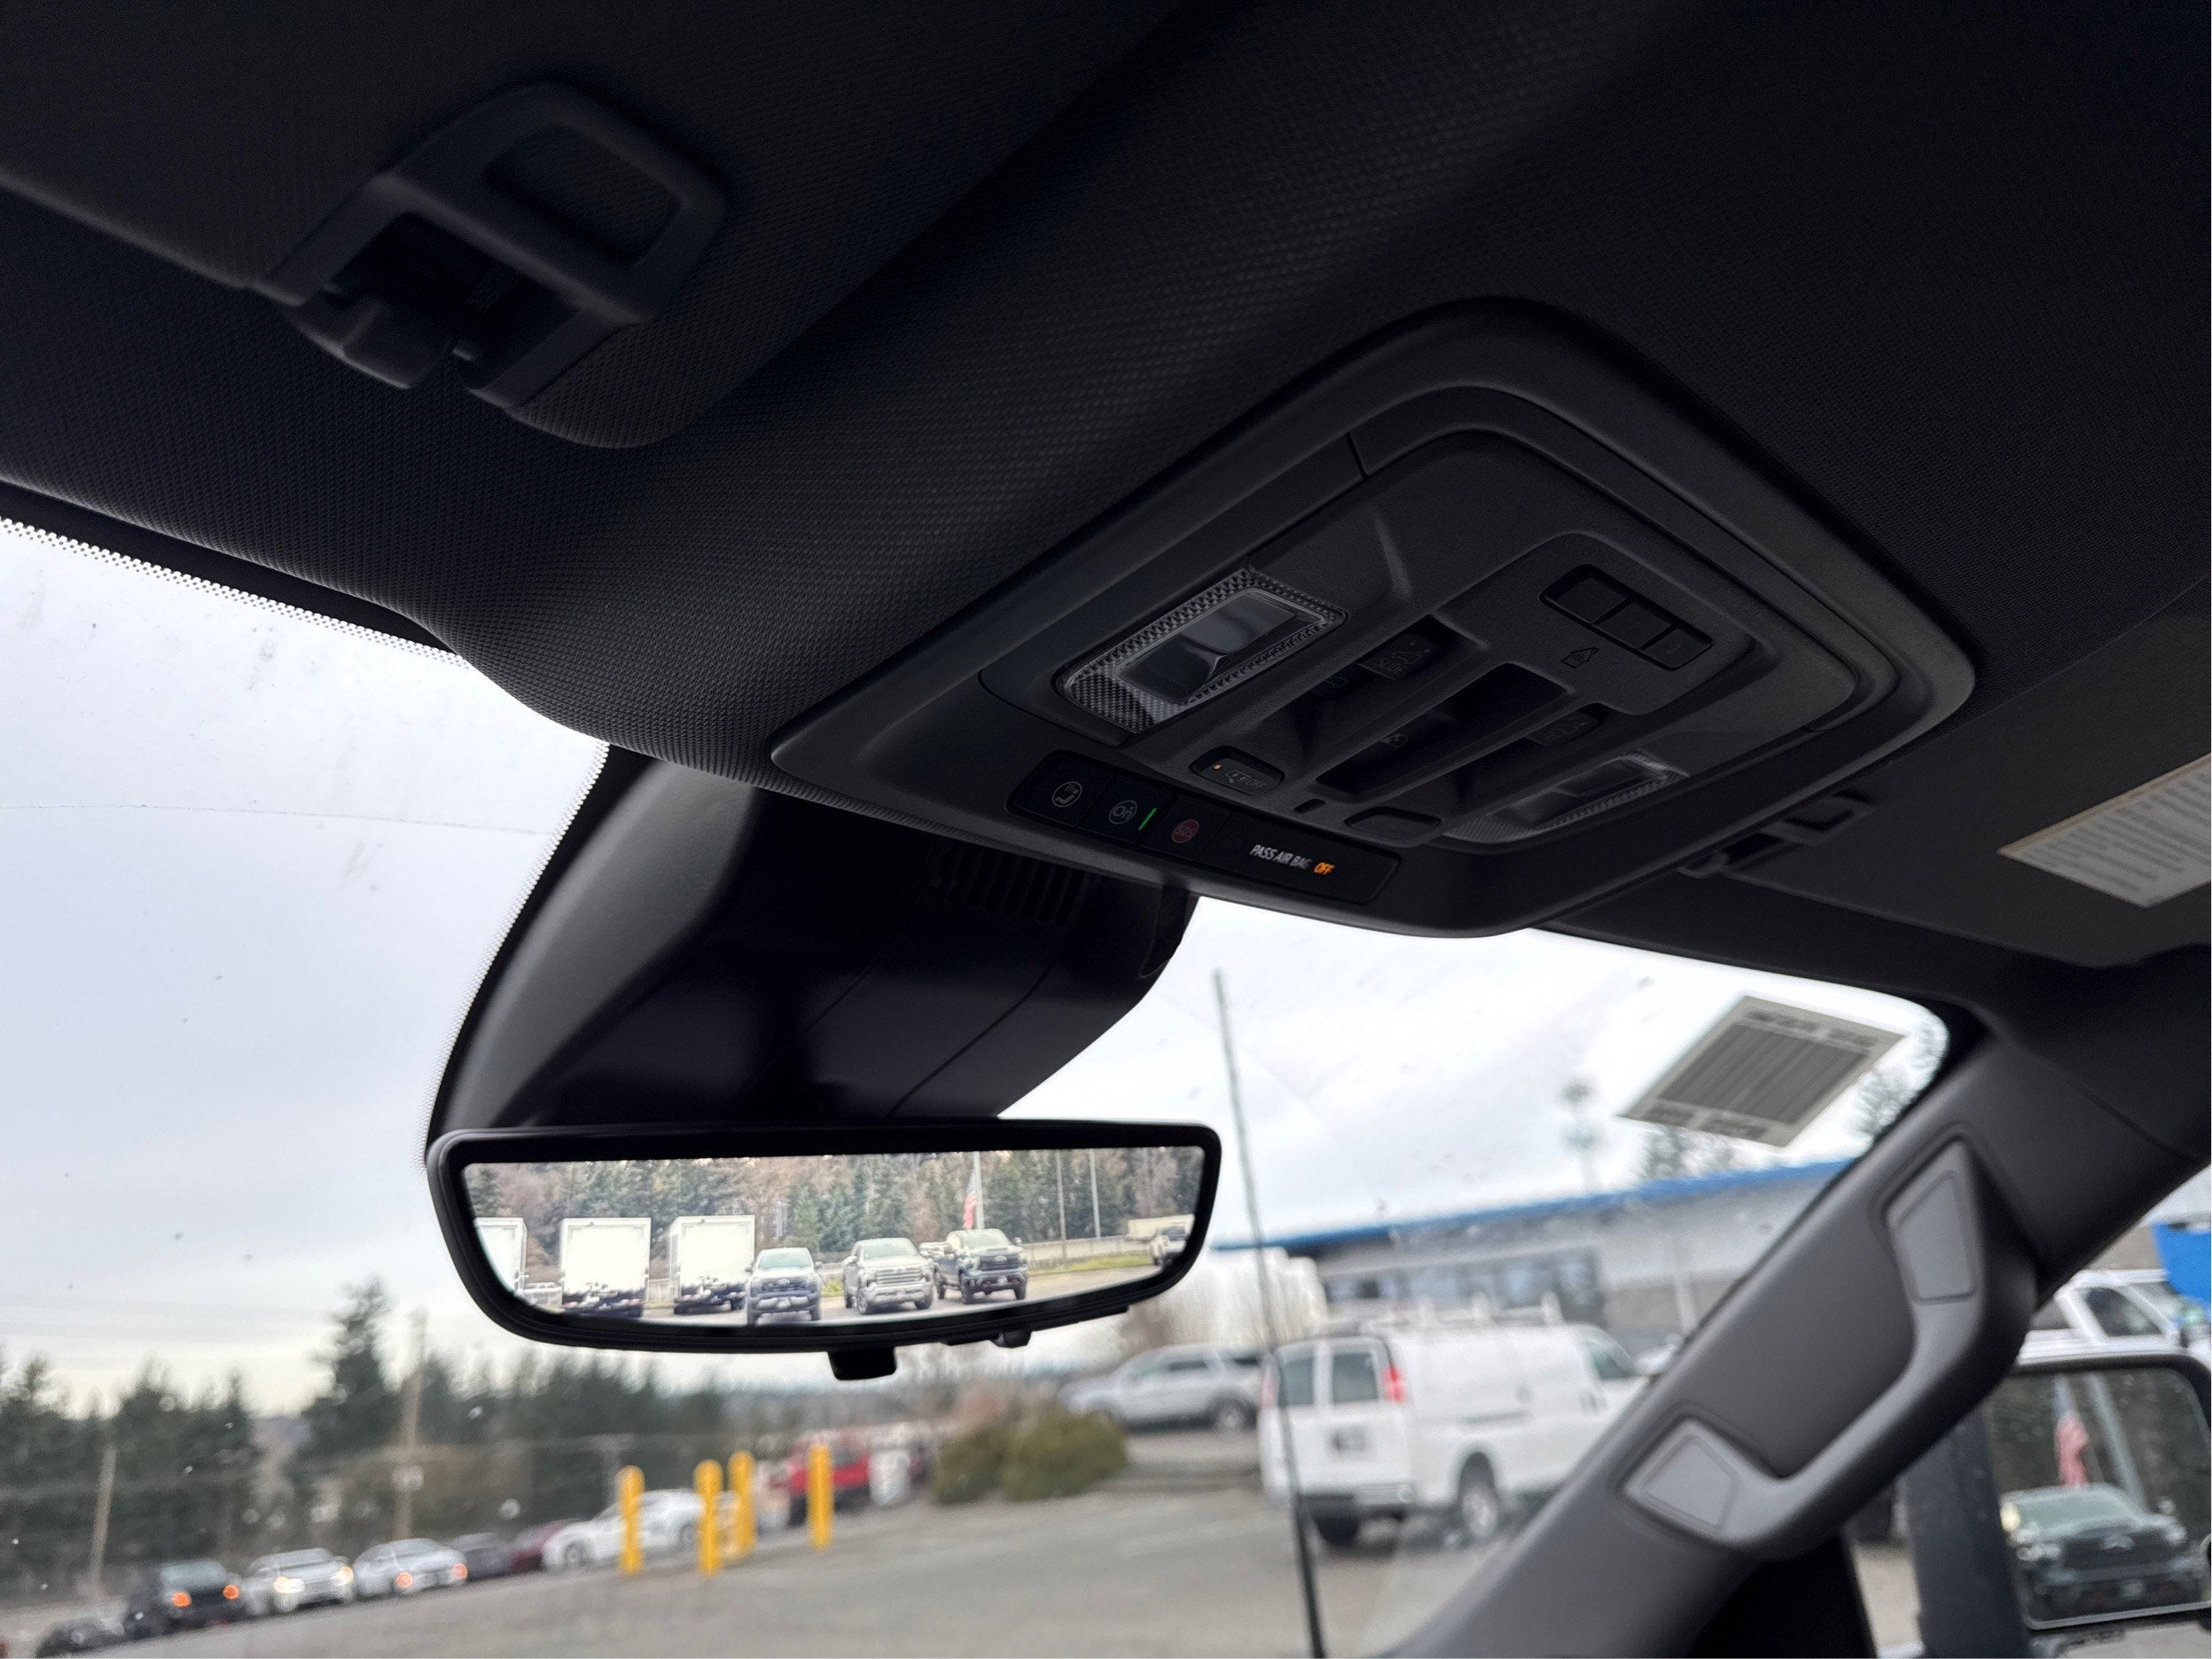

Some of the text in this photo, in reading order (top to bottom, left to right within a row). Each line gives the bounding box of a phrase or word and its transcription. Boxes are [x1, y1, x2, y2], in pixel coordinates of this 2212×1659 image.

[1176, 824, 1196, 837] SOS
[1249, 844, 1336, 875] PASS AIR BAG OFF
